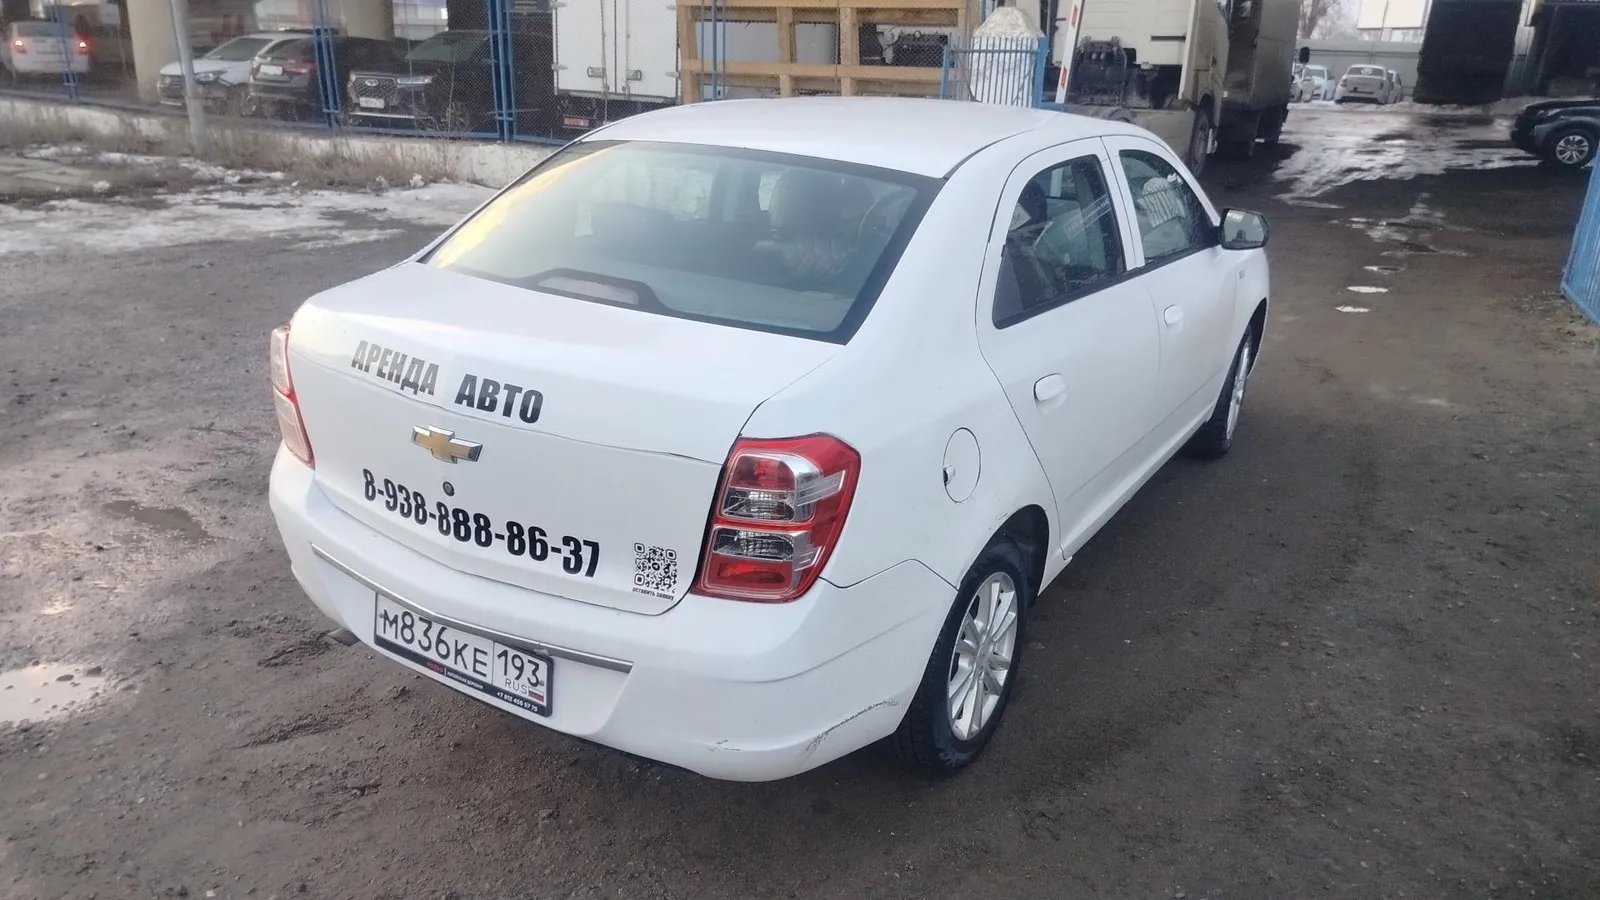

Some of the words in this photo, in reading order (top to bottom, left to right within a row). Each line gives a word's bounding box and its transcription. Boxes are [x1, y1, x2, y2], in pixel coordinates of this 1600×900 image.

[351, 340, 440, 396] АРЕНДА
[454, 373, 544, 424] АВТО
[362, 468, 600, 578] 8-938-888-86-37
[497, 649, 541, 687] 193
[504, 678, 528, 695] RUS
